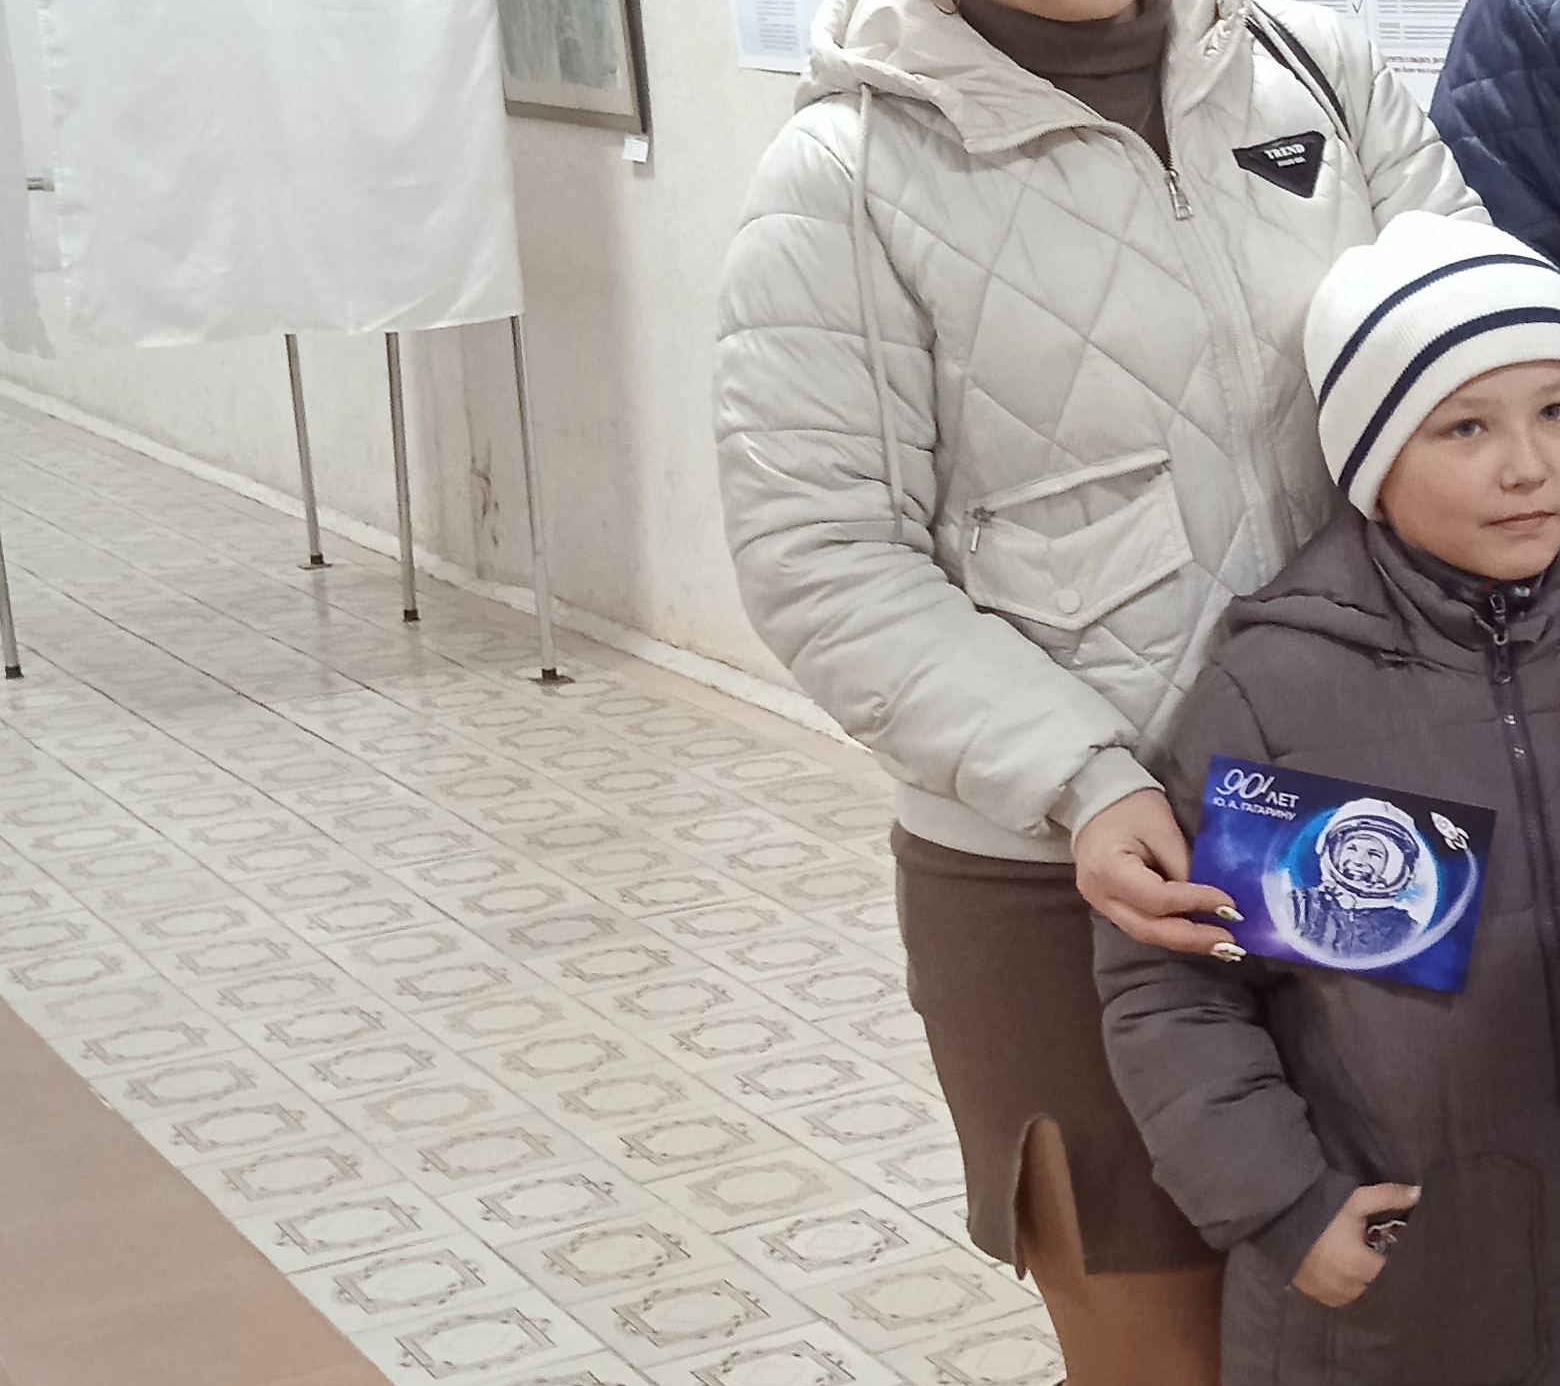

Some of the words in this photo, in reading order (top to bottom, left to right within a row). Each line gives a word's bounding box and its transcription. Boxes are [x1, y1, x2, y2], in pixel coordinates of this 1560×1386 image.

[1263, 143, 1306, 160] TREND
[1264, 791, 1300, 809] ЛЕТ
[1240, 801, 1297, 821] ГАГАРИНУ
